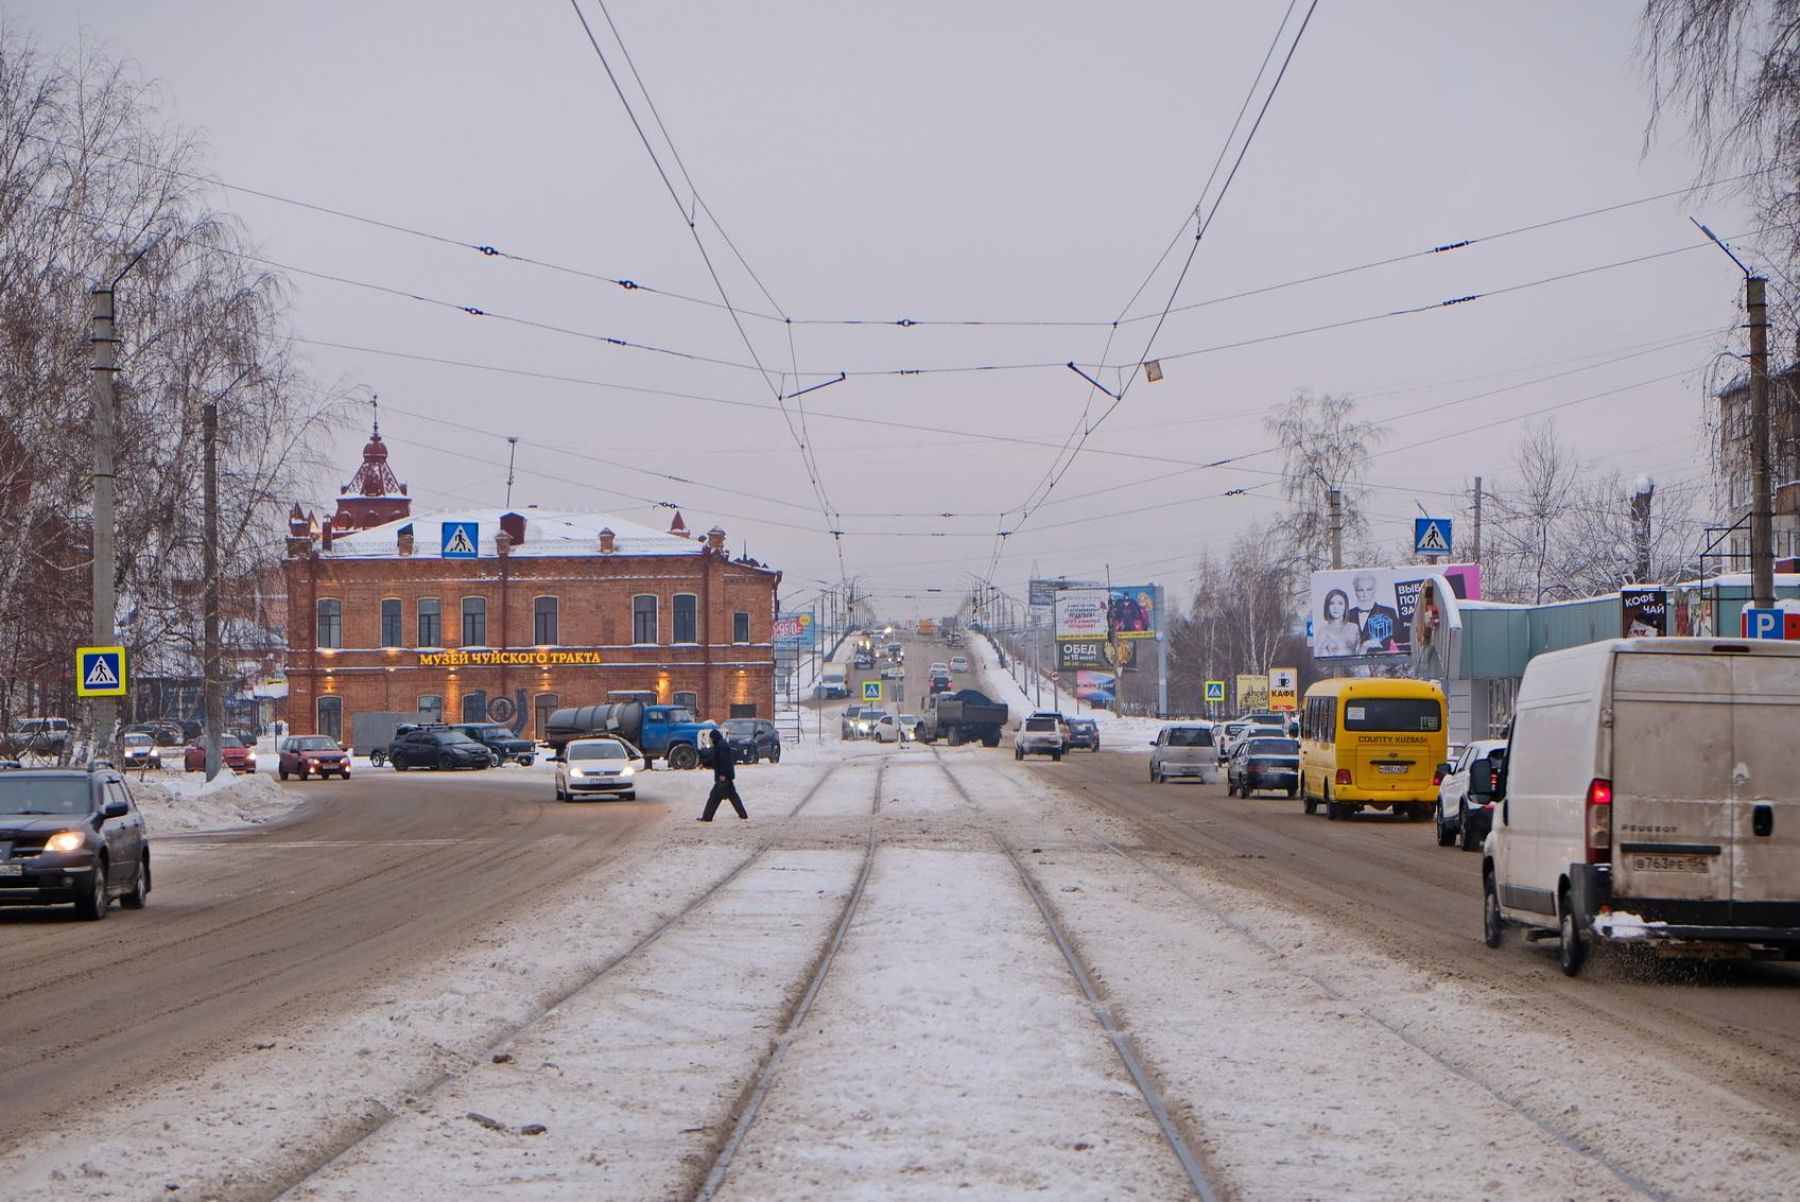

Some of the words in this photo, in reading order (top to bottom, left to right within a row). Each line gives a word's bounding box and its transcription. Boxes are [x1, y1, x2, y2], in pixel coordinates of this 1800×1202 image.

[1625, 592, 1656, 607] КОФЕ
[1643, 603, 1665, 614] ЧАЙ
[1063, 644, 1097, 656] ОБЕД
[420, 650, 469, 666] МУЗЕЙ
[471, 649, 548, 665] ЧУЙСКОГО
[550, 652, 601, 664] ТРАКТА
[1271, 690, 1296, 698] КАФЕ
[1621, 824, 1679, 833] PEUGEOT
